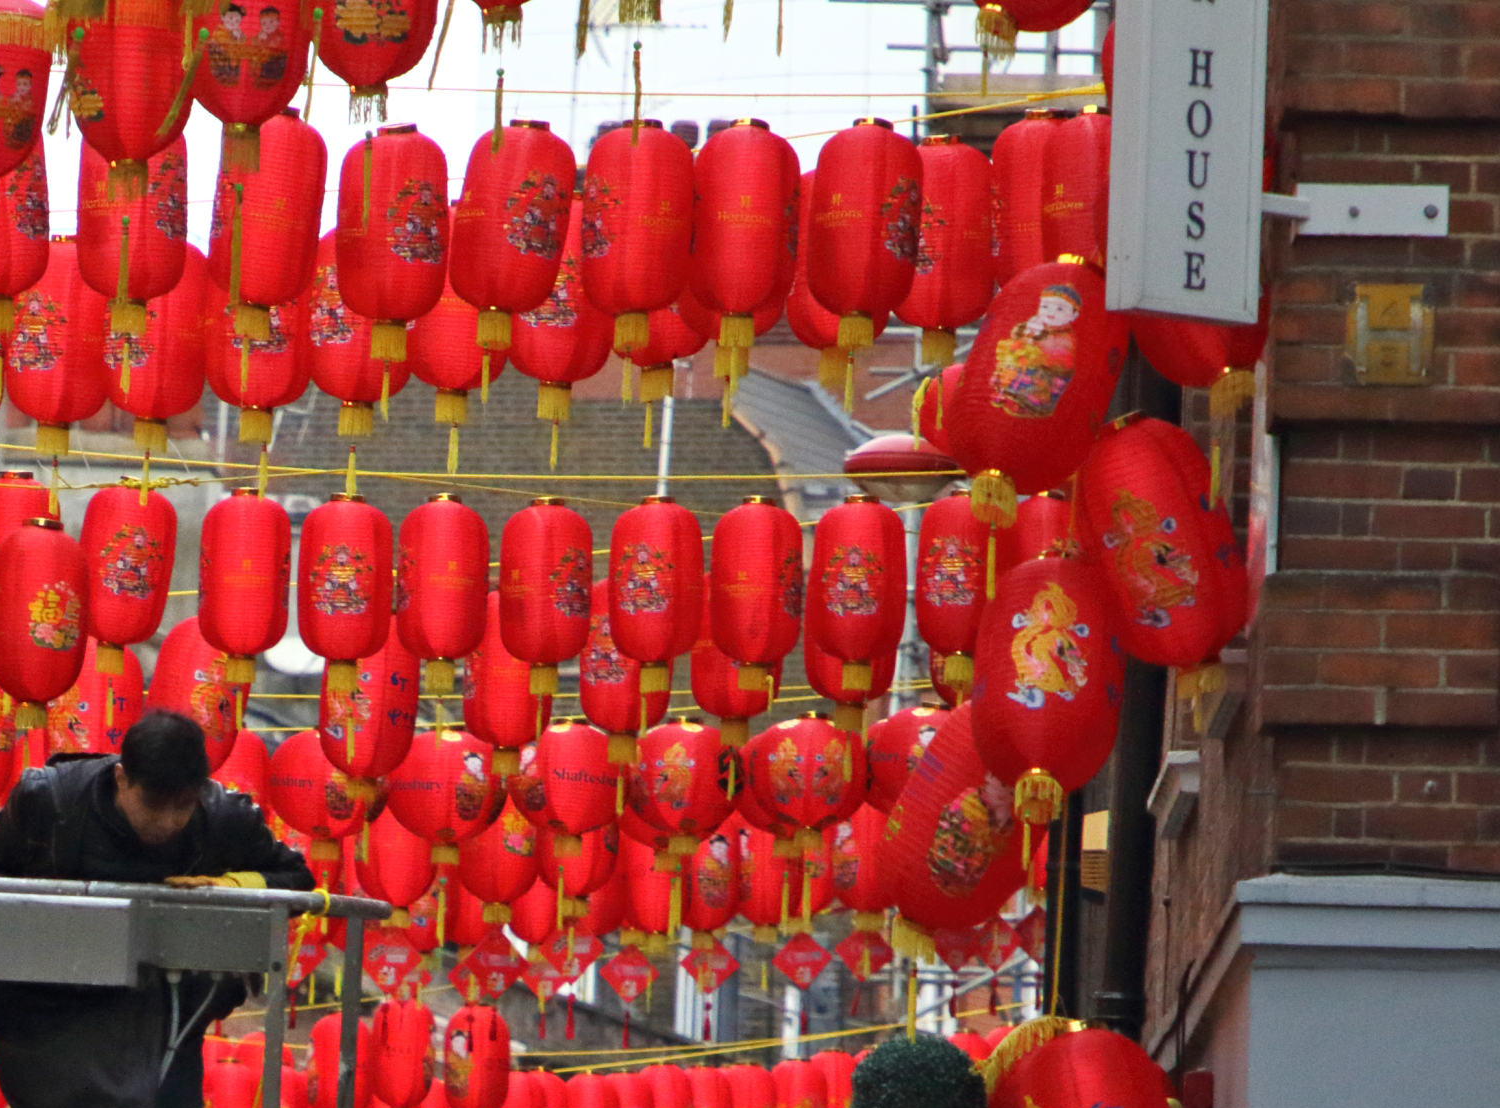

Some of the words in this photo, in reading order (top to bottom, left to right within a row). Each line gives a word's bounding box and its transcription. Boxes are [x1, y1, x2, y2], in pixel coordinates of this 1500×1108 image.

[1183, 48, 1214, 290] HOUSE
[718, 211, 772, 225] Horizons
[816, 209, 863, 222] Horizons
